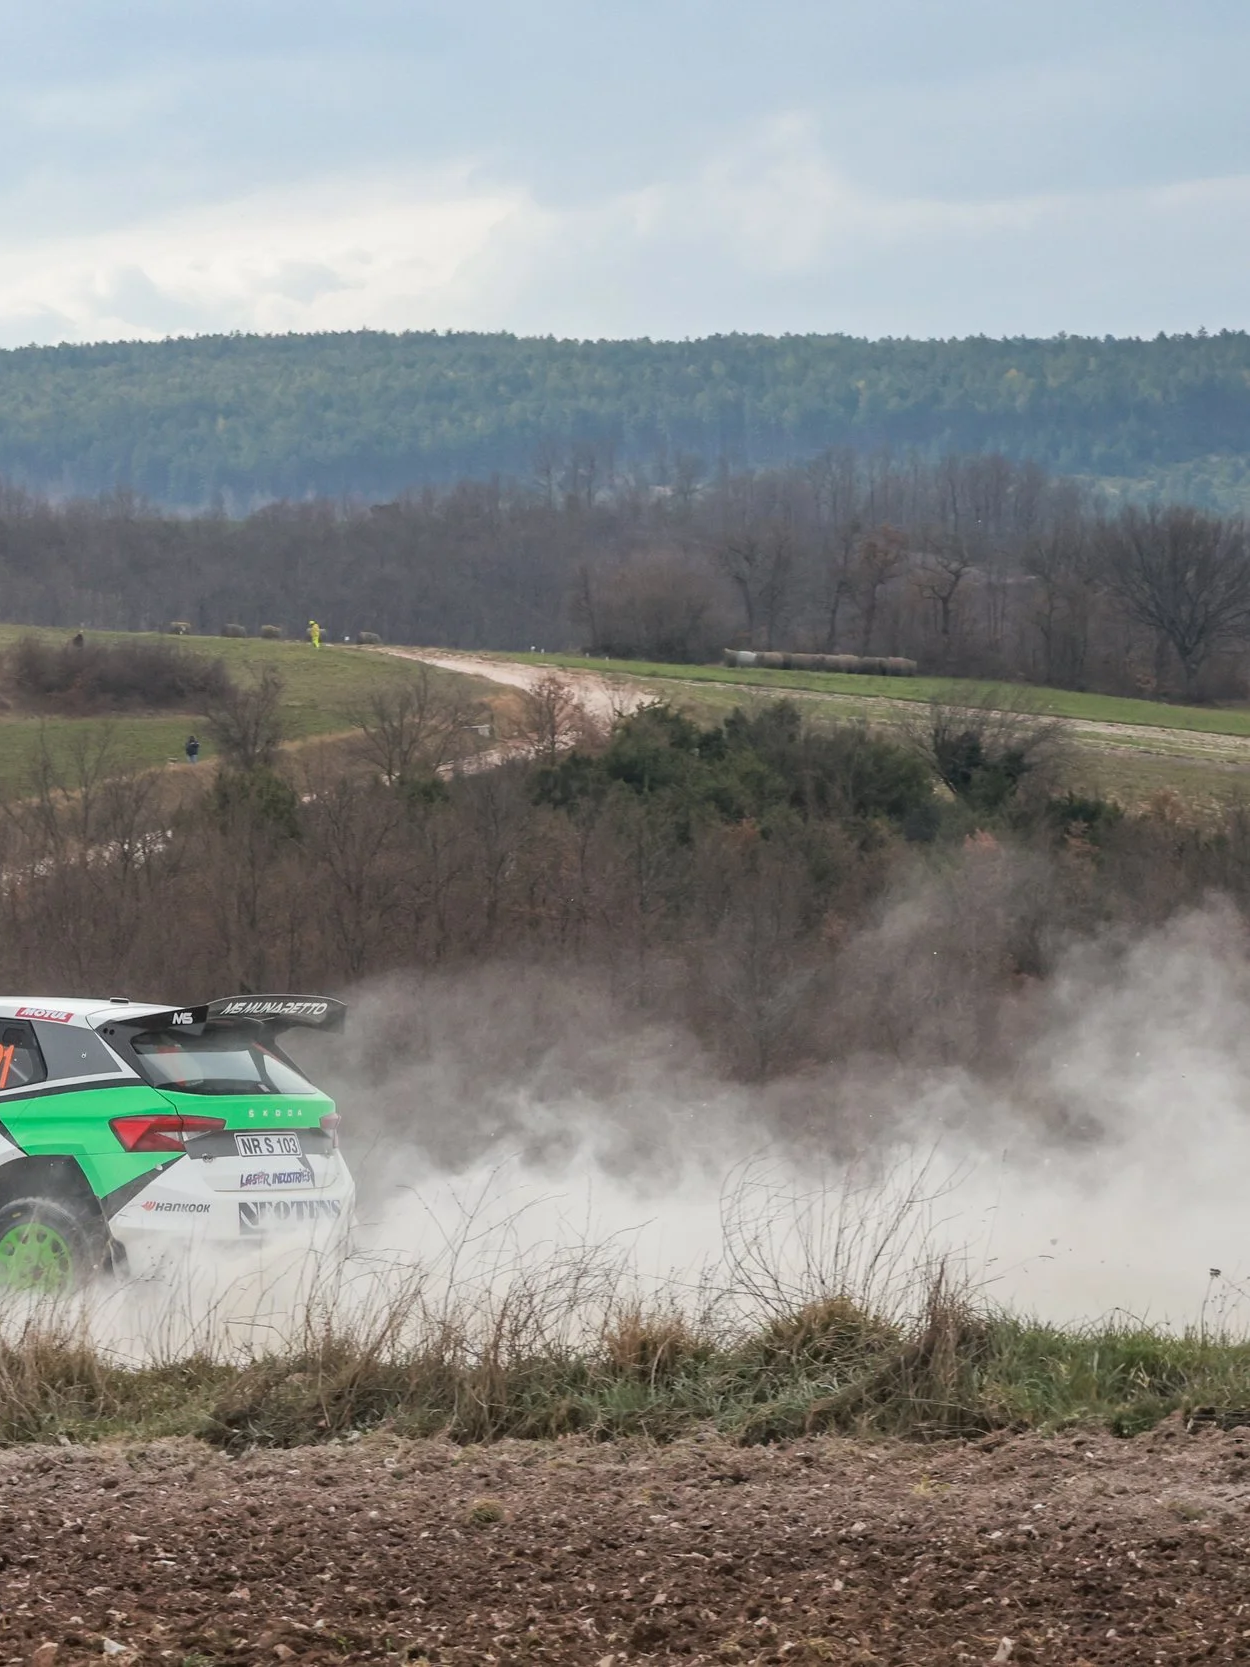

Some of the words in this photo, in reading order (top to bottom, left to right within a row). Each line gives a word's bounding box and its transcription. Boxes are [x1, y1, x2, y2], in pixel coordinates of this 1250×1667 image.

[20, 1008, 73, 1021] MOTUL
[240, 1002, 328, 1015] MUNARETTO
[172, 1012, 193, 1025] MS
[241, 1137, 263, 1154] NR
[265, 1138, 275, 1154] S
[277, 1137, 298, 1154] 103
[240, 1172, 271, 1188] LASER
